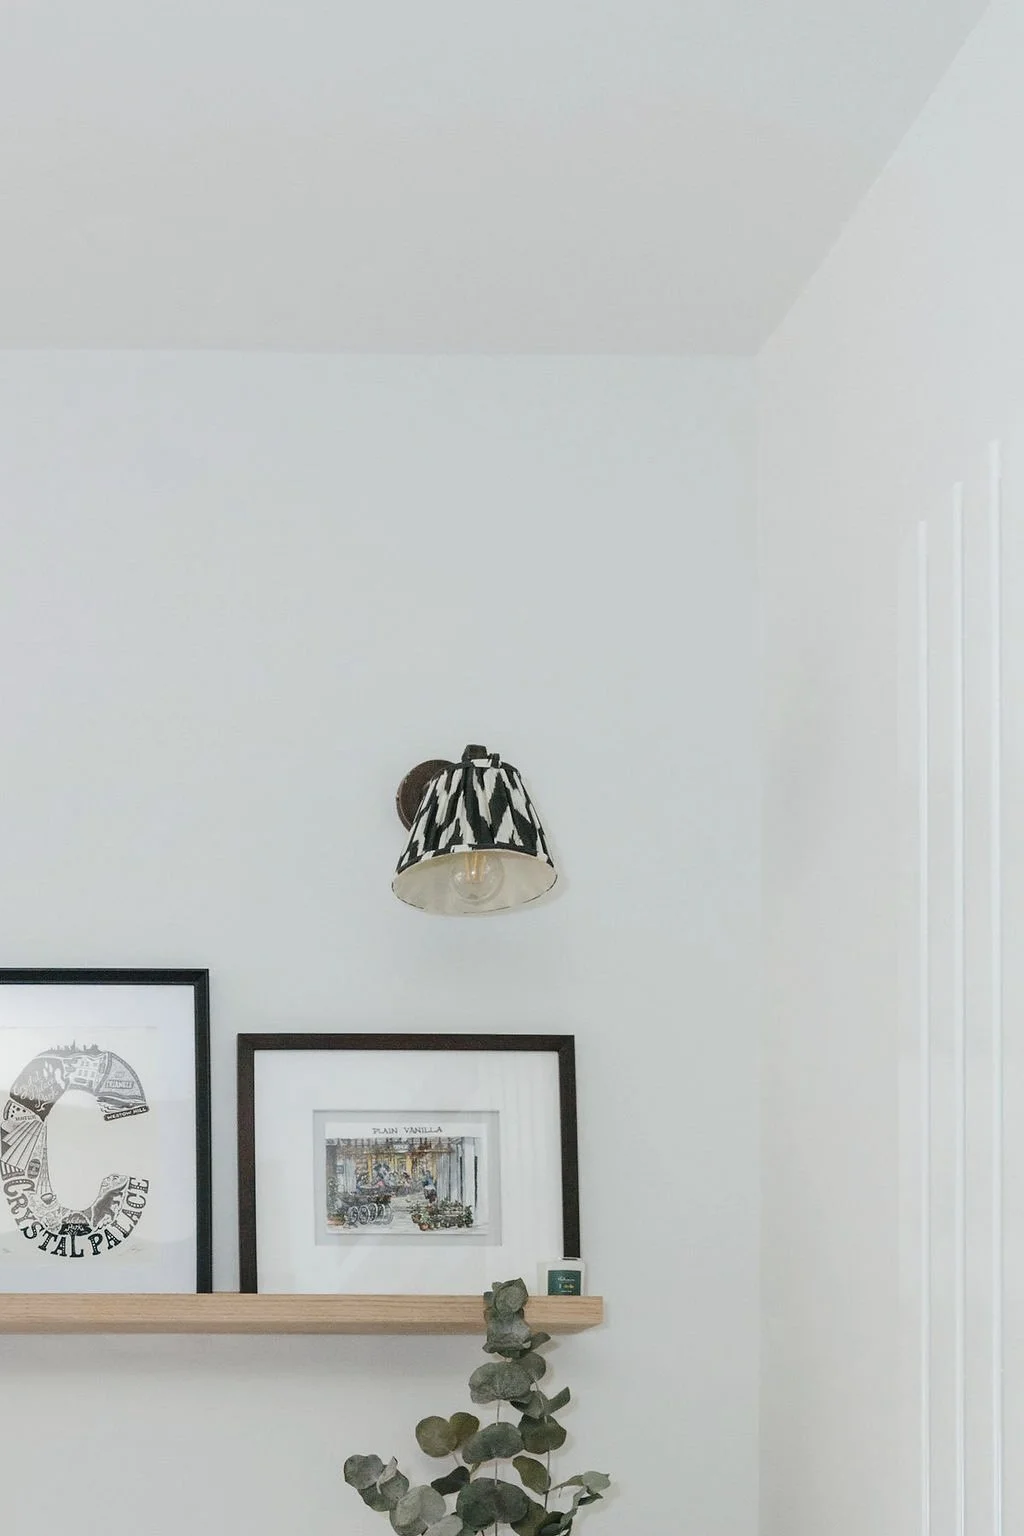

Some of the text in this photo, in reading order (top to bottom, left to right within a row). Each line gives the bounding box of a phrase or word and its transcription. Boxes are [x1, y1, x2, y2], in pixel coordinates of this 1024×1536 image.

[404, 1126, 443, 1134] VANILLA
[3, 1176, 150, 1258] CRYSTAL PALACE
